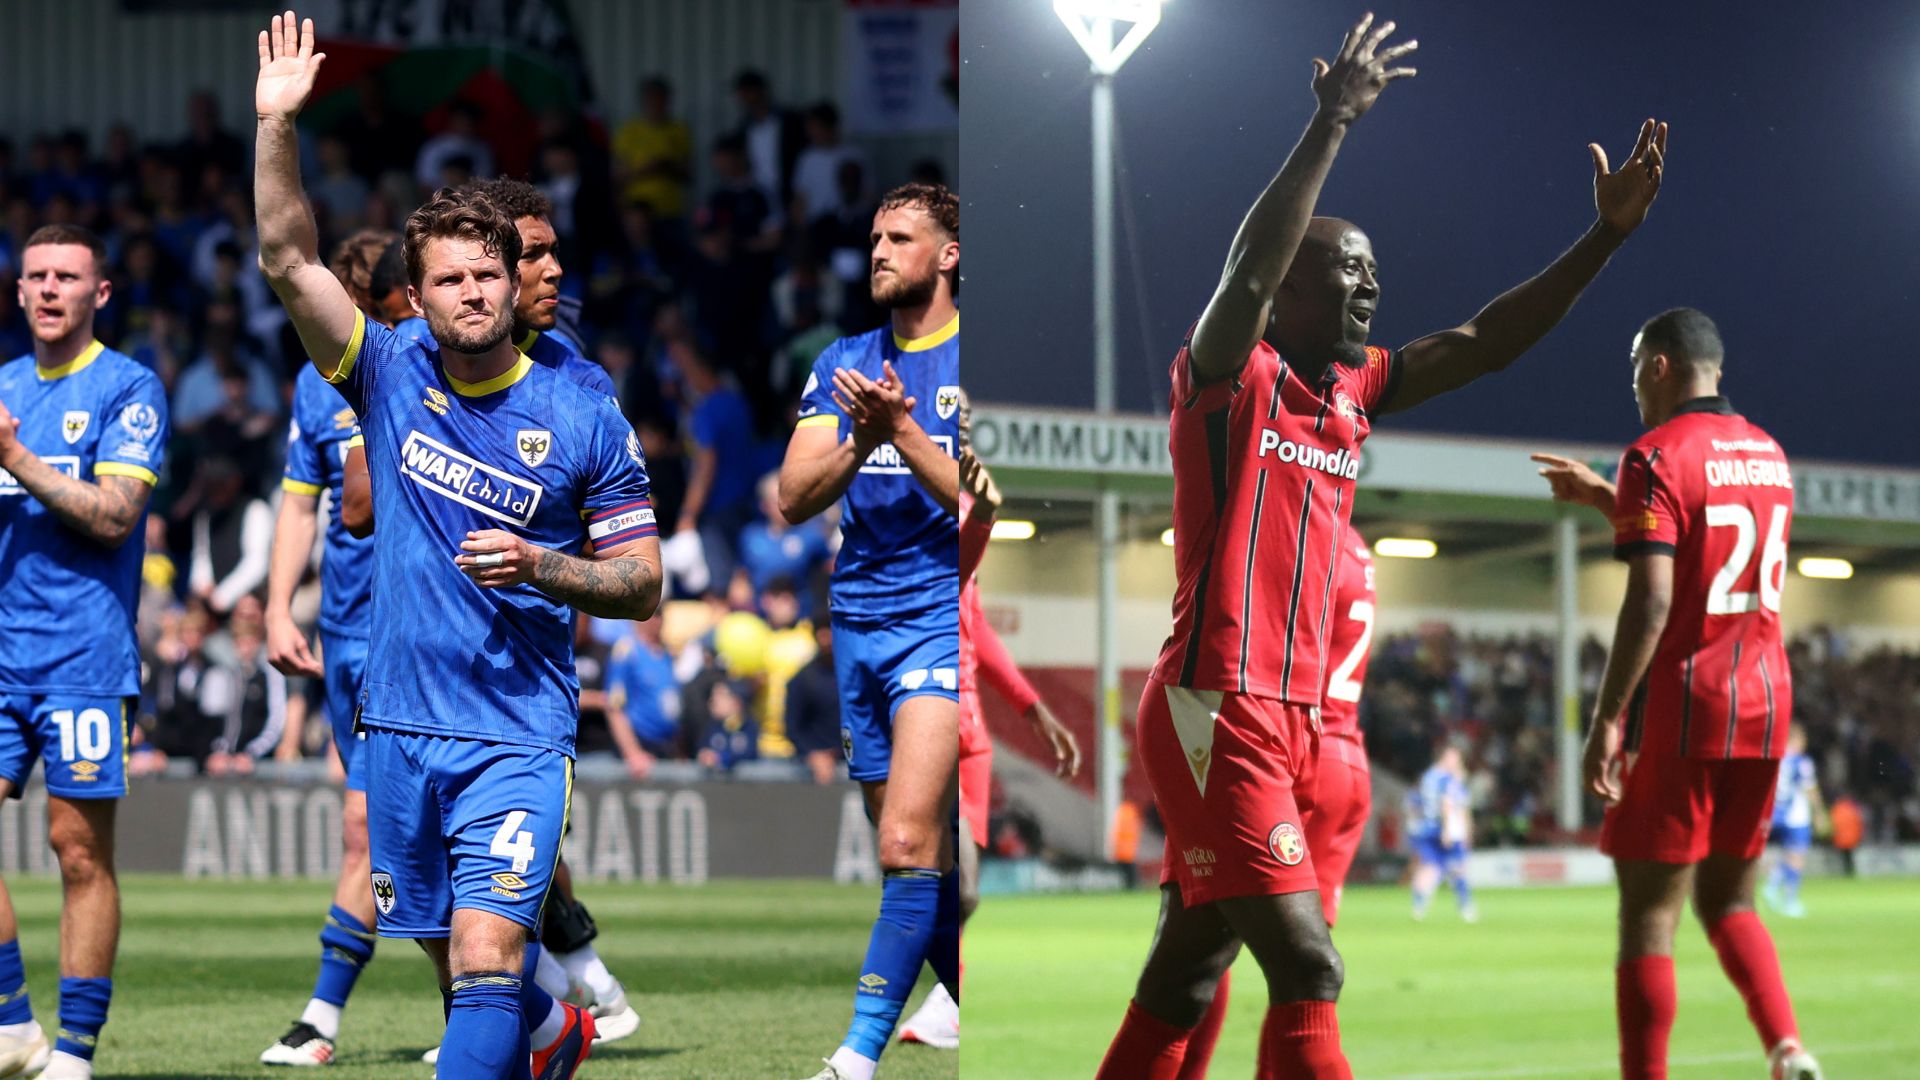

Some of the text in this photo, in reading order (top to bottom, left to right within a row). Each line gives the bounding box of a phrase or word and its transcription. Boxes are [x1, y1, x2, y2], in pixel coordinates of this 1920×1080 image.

[423, 398, 447, 416] umbro
[406, 442, 529, 514] WAR child
[1705, 459, 1793, 489] OKAGBUE
[621, 516, 635, 525] EFL
[1704, 504, 1788, 615] 26
[51, 707, 111, 762] 10
[490, 810, 536, 874] 4
[491, 885, 521, 900] umbro
